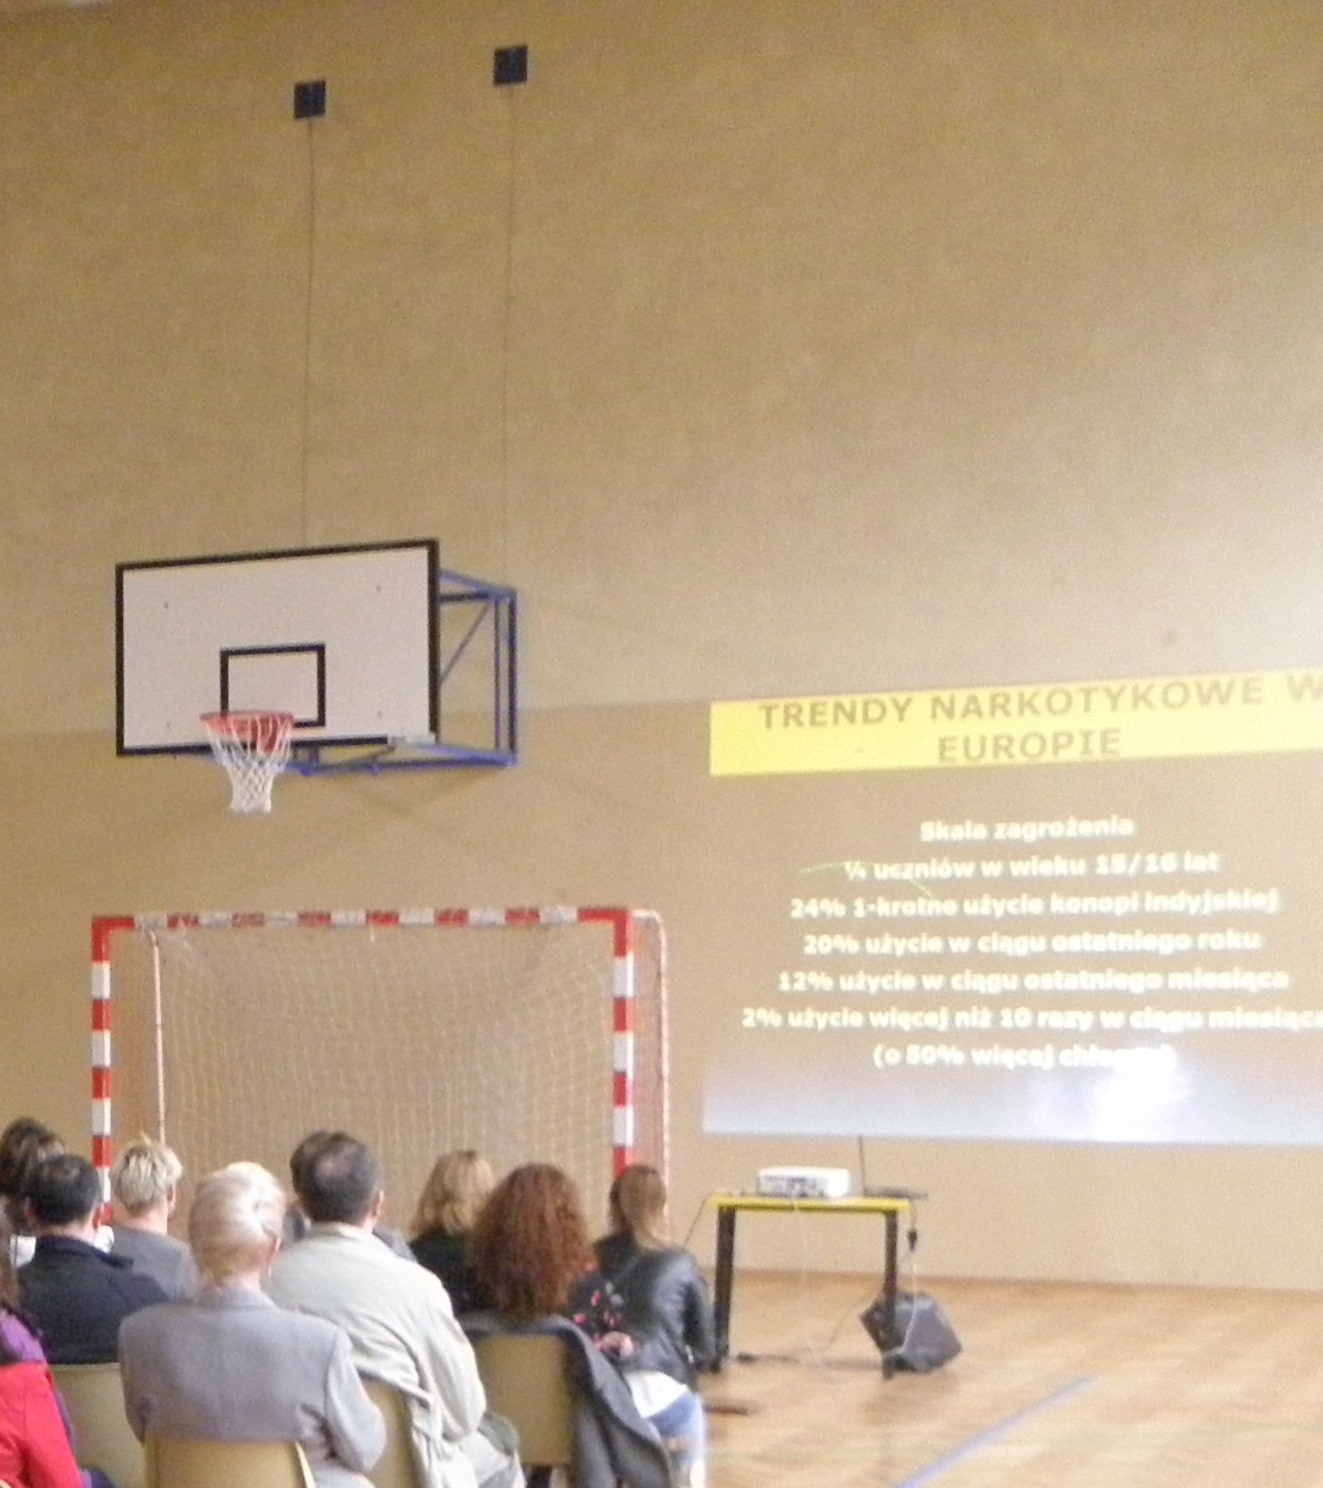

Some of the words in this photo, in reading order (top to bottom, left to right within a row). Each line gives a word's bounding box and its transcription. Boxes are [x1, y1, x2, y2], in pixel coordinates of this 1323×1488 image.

[759, 697, 912, 729] TRENDY
[930, 677, 1264, 720] NARKOTYKOWE
[1285, 673, 1323, 699] W
[937, 727, 1120, 762] EUROPIE
[920, 820, 988, 842] Skala
[994, 815, 1135, 842] zagrożenia
[874, 857, 975, 880] uczniów
[980, 861, 1003, 878] w
[1009, 855, 1086, 876] wieku
[1096, 852, 1178, 877] 15/16
[1184, 851, 1221, 873] lat
[790, 898, 846, 919] 24%
[853, 897, 957, 919] 1-krotne
[963, 893, 1044, 918] użycie
[1050, 891, 1140, 916] konopi
[804, 934, 859, 955] 20%
[865, 932, 943, 957] użycie
[948, 936, 971, 953] w
[977, 932, 1047, 957] ciągu
[1051, 929, 1193, 955] ostatniego
[1197, 928, 1261, 950] roku
[778, 971, 833, 992] 12%
[839, 970, 916, 994] użycie
[921, 973, 945, 990] w
[950, 969, 1018, 994] ciągu
[1023, 967, 1163, 993] ostatniego
[742, 1007, 782, 1028] 2%
[787, 1006, 863, 1031] użycie
[869, 1006, 948, 1032] więcej
[955, 1005, 992, 1028] niż
[1000, 1006, 1032, 1028] 10
[1099, 1010, 1125, 1028] w
[970, 1044, 1053, 1069] więcej
